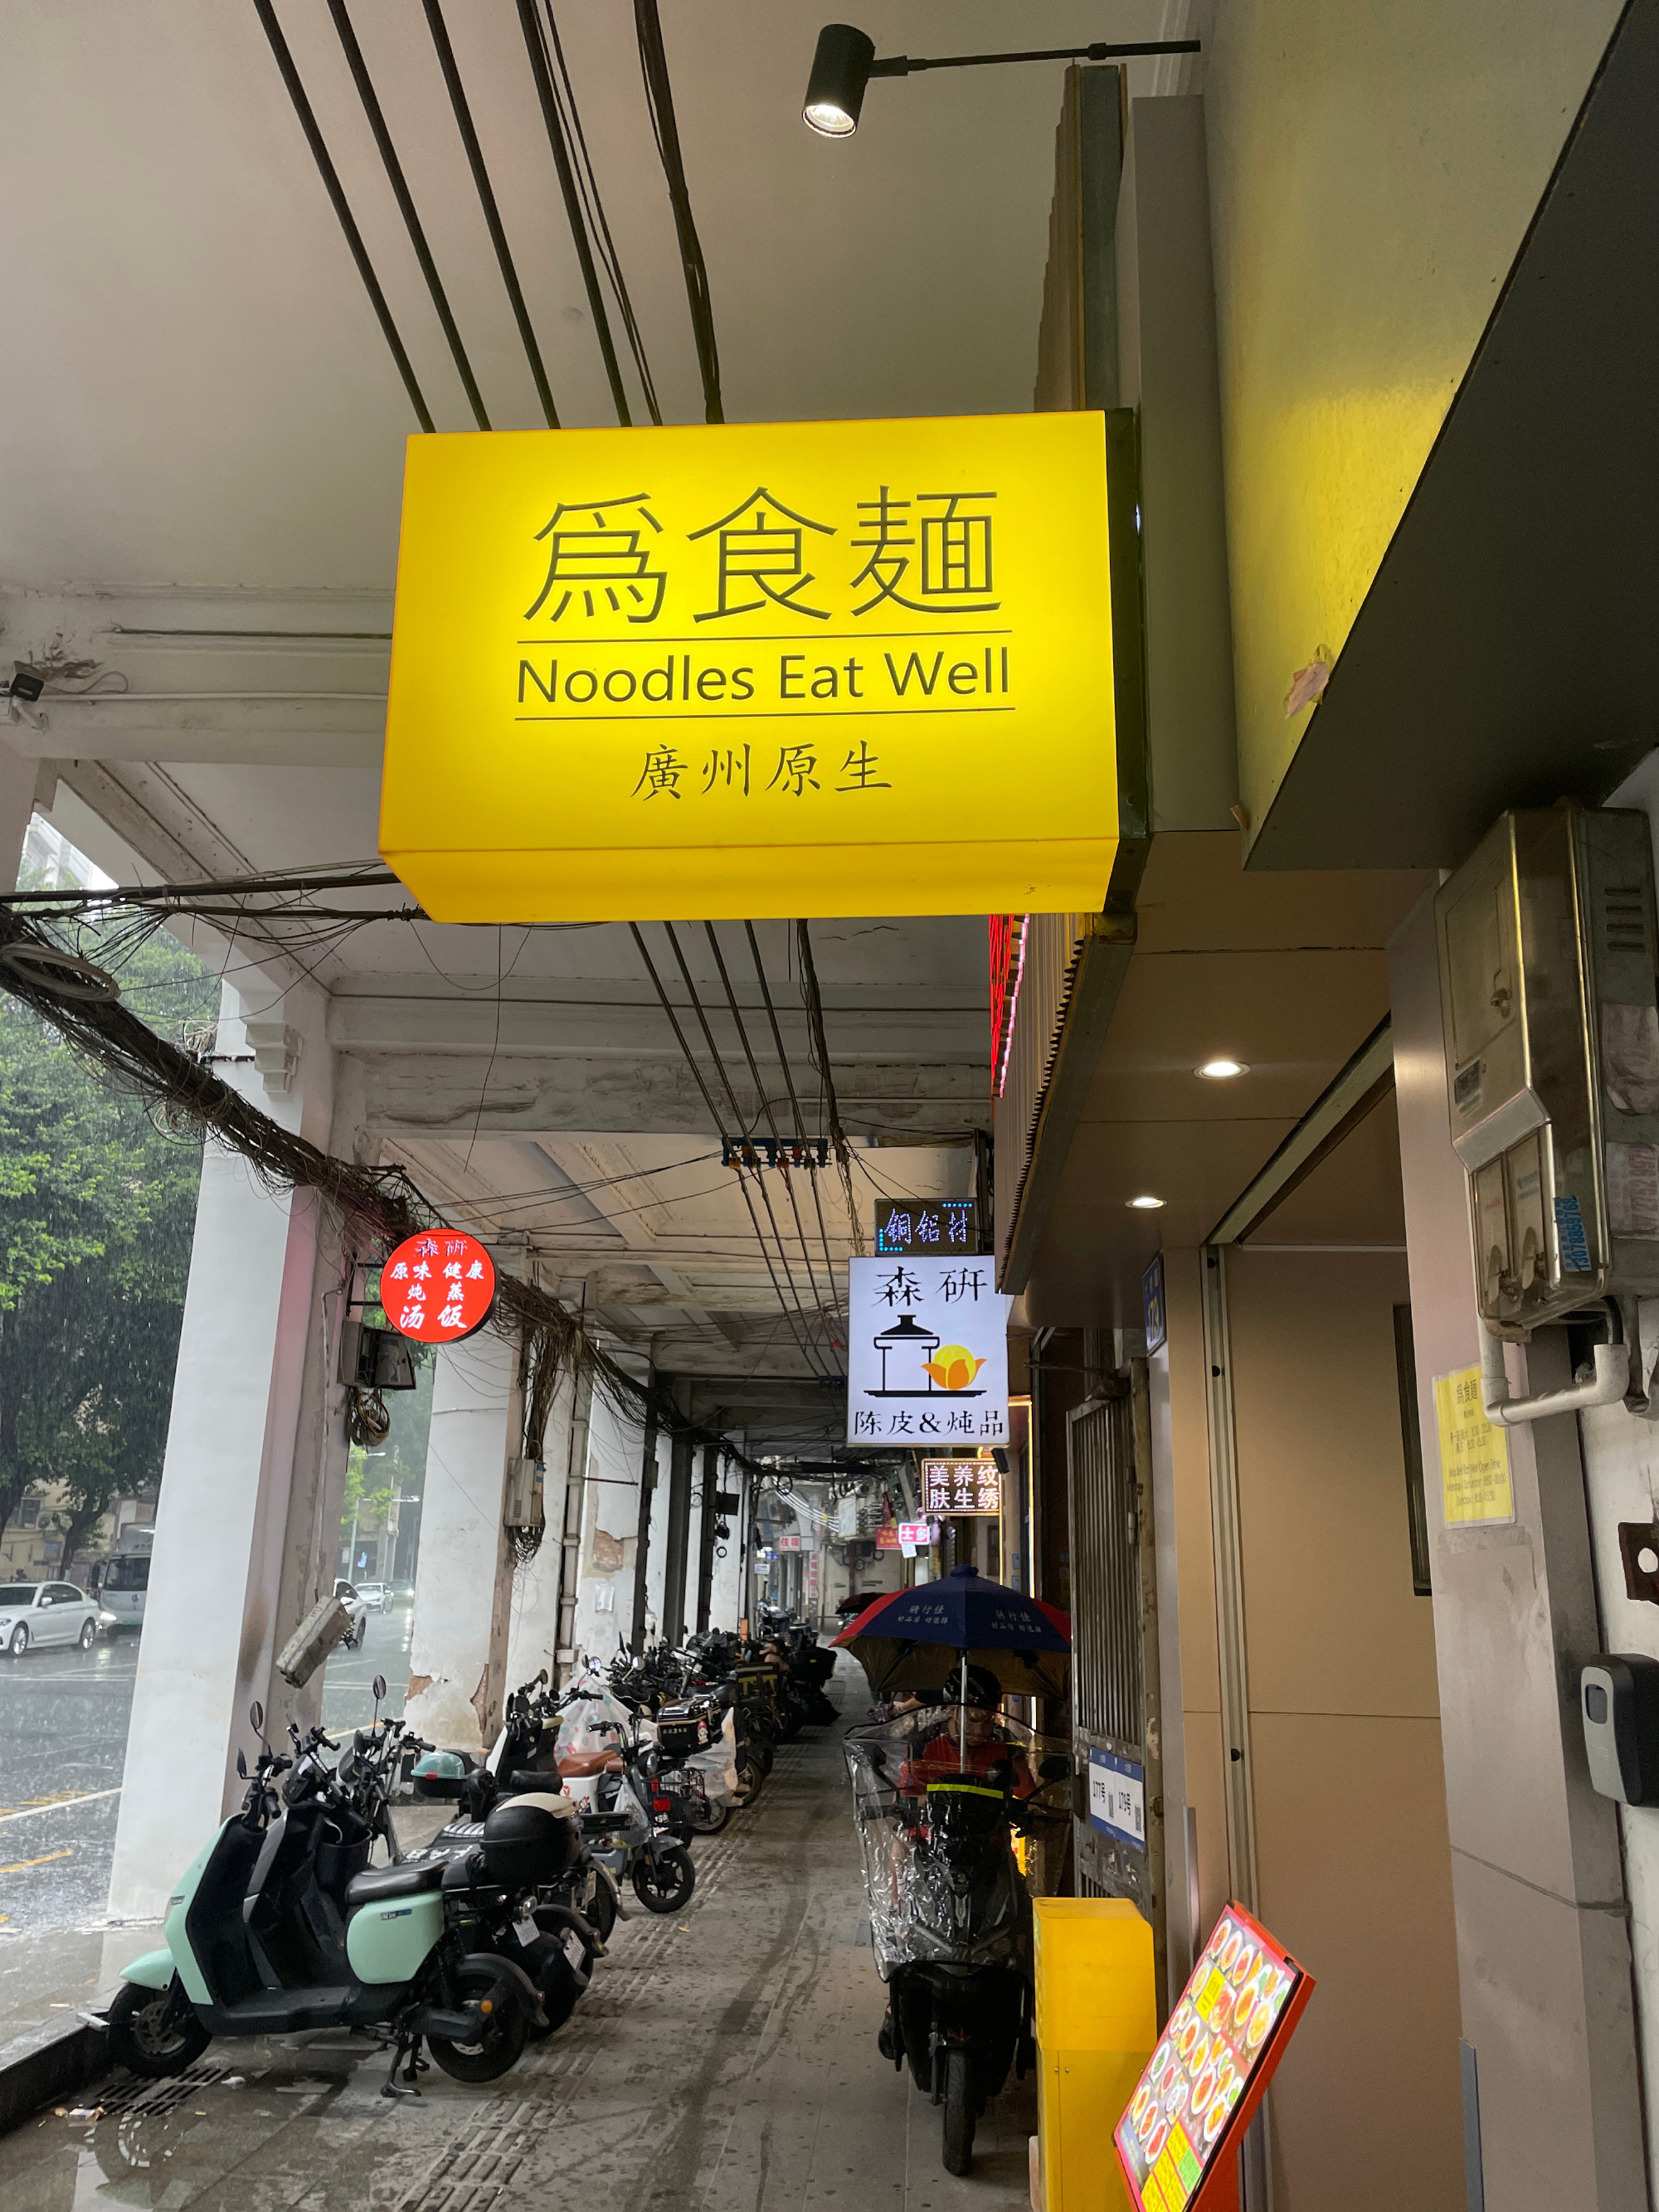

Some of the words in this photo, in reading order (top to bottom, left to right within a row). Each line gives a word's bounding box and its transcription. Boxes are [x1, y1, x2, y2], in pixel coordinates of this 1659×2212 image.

[518, 655, 754, 702] Noodles
[781, 655, 863, 698] Eat
[885, 647, 1008, 695] Well
[630, 741, 892, 800] 廣州原生
[884, 1208, 968, 1243] 铜铝材
[390, 1260, 432, 1281] 原味
[442, 1259, 484, 1281] 健康
[407, 1284, 426, 1301] 炖
[447, 1281, 465, 1301] 蒸
[400, 1305, 425, 1330] 汤
[437, 1305, 468, 1329] 饭
[854, 1410, 1003, 1437] 陈皮&炖品
